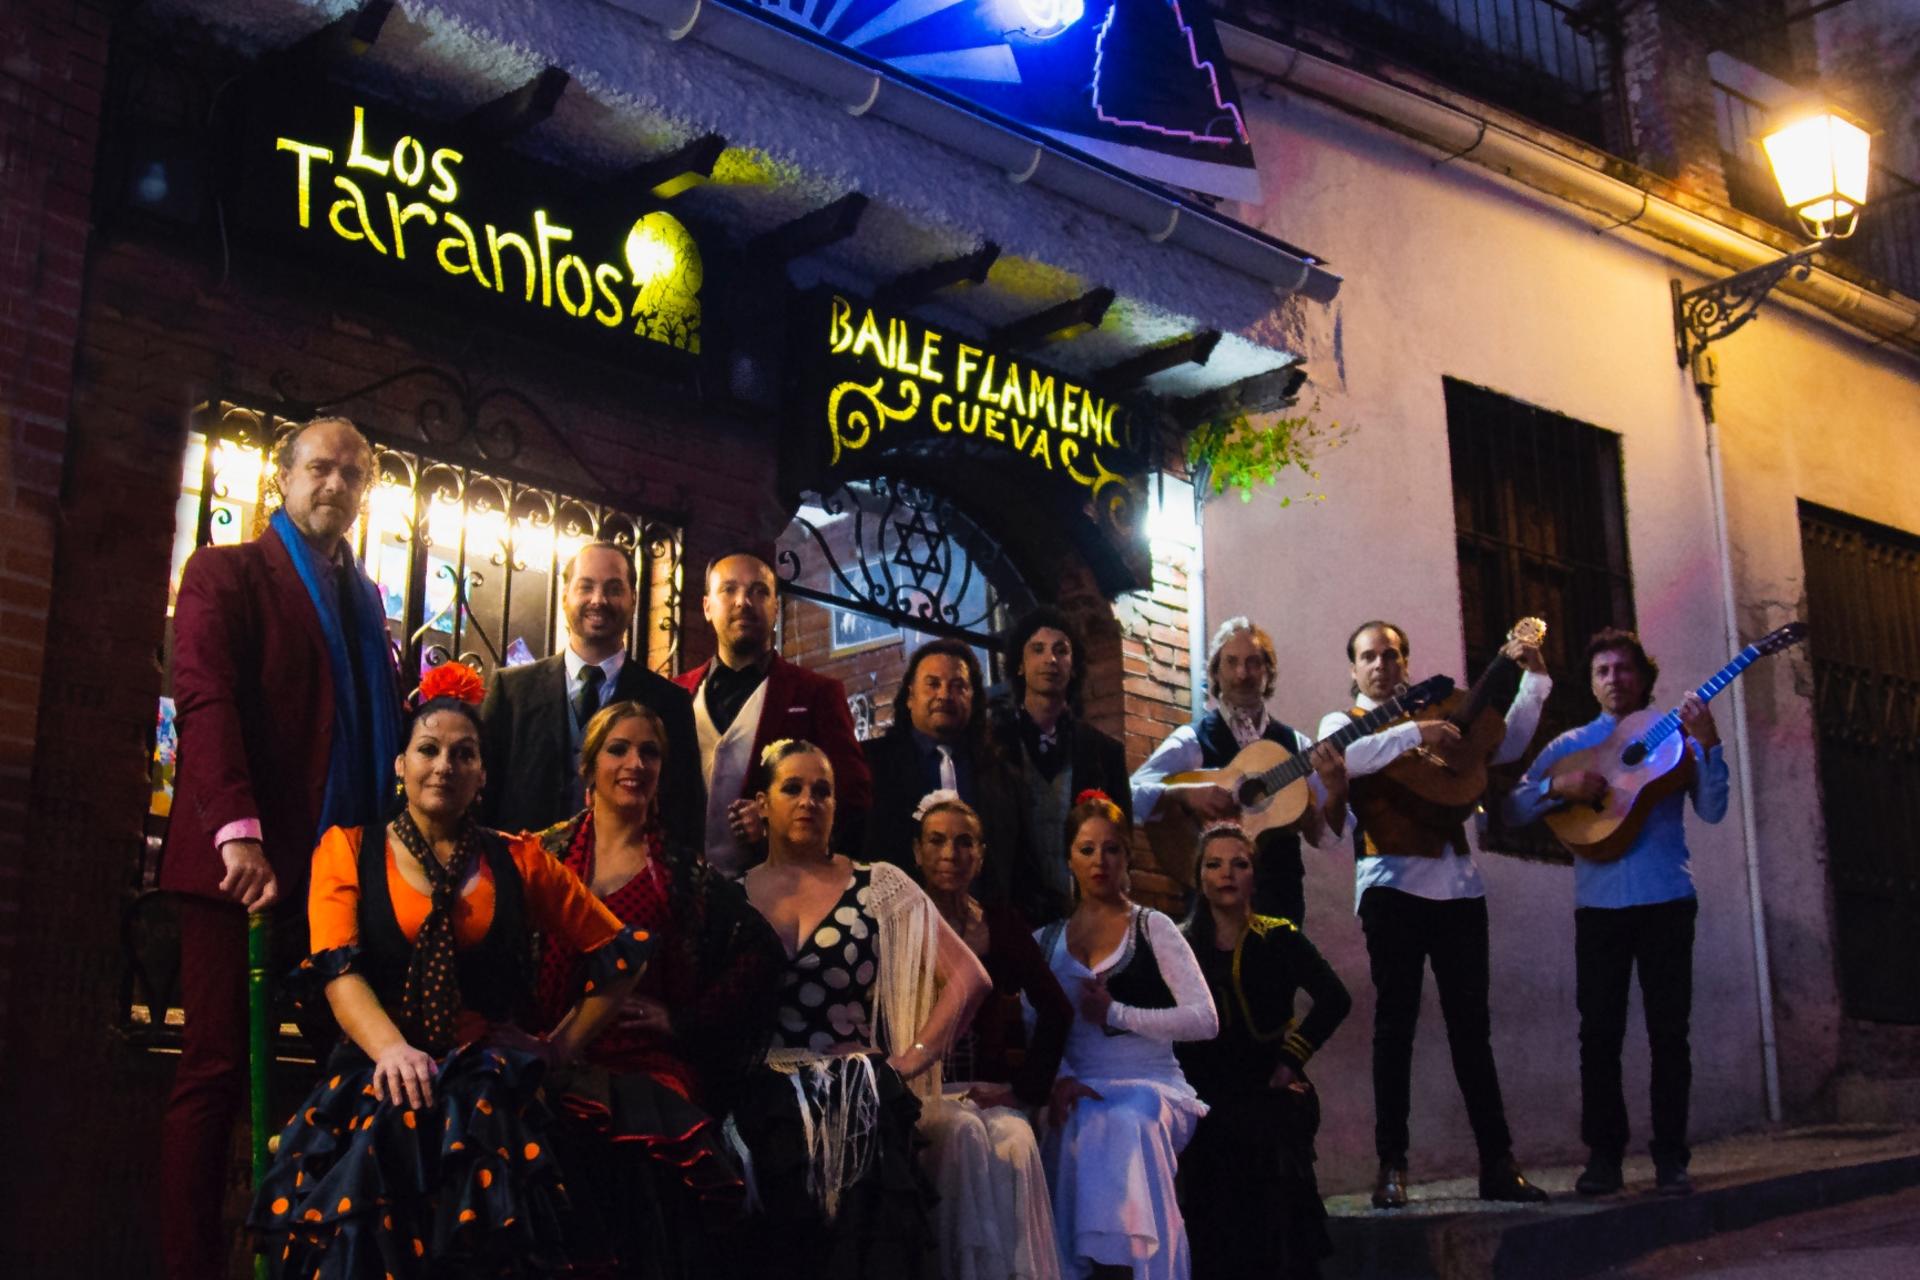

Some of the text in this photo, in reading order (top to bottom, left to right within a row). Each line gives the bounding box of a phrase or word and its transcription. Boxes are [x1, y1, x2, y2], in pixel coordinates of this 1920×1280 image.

[347, 105, 463, 203] Los
[276, 137, 624, 328] Tarantos
[829, 295, 1132, 447] BAILE FLAMENC
